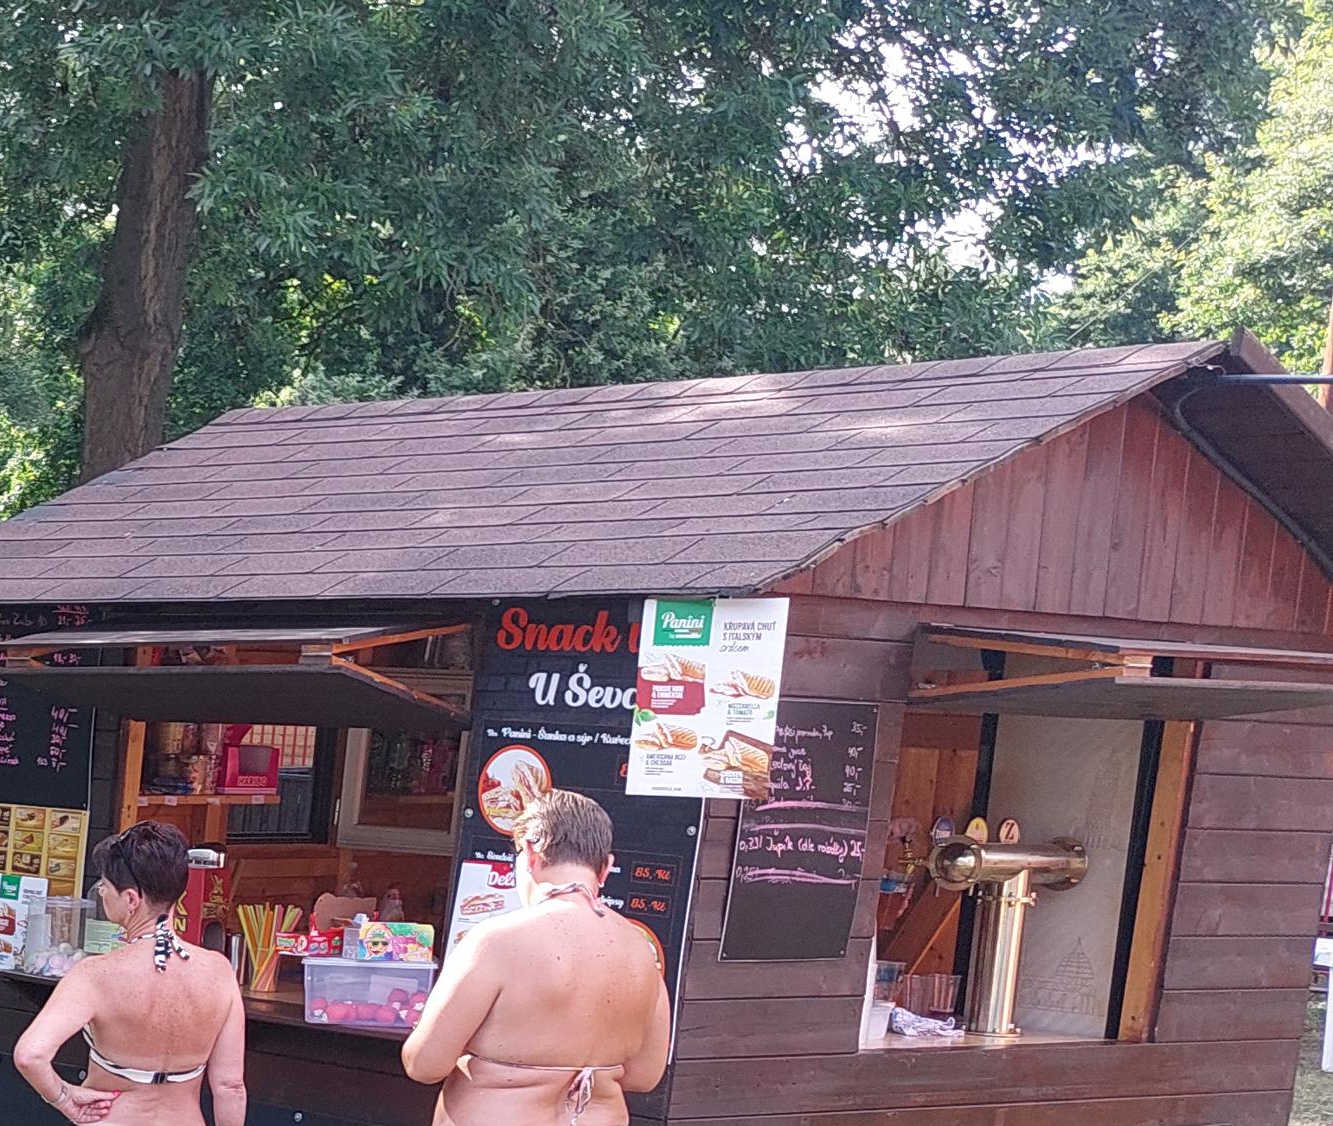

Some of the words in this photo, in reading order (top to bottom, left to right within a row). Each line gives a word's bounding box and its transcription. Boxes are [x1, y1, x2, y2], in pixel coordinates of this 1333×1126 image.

[496, 607, 621, 654] Snack
[661, 612, 706, 629] Panini
[723, 620, 756, 631] KRUPAVÁ
[528, 672, 561, 706] U
[564, 663, 637, 710] Ševc
[501, 726, 532, 739] Panini
[567, 733, 575, 741] a
[576, 733, 593, 746] sýr
[600, 733, 631, 745] Kuřec
